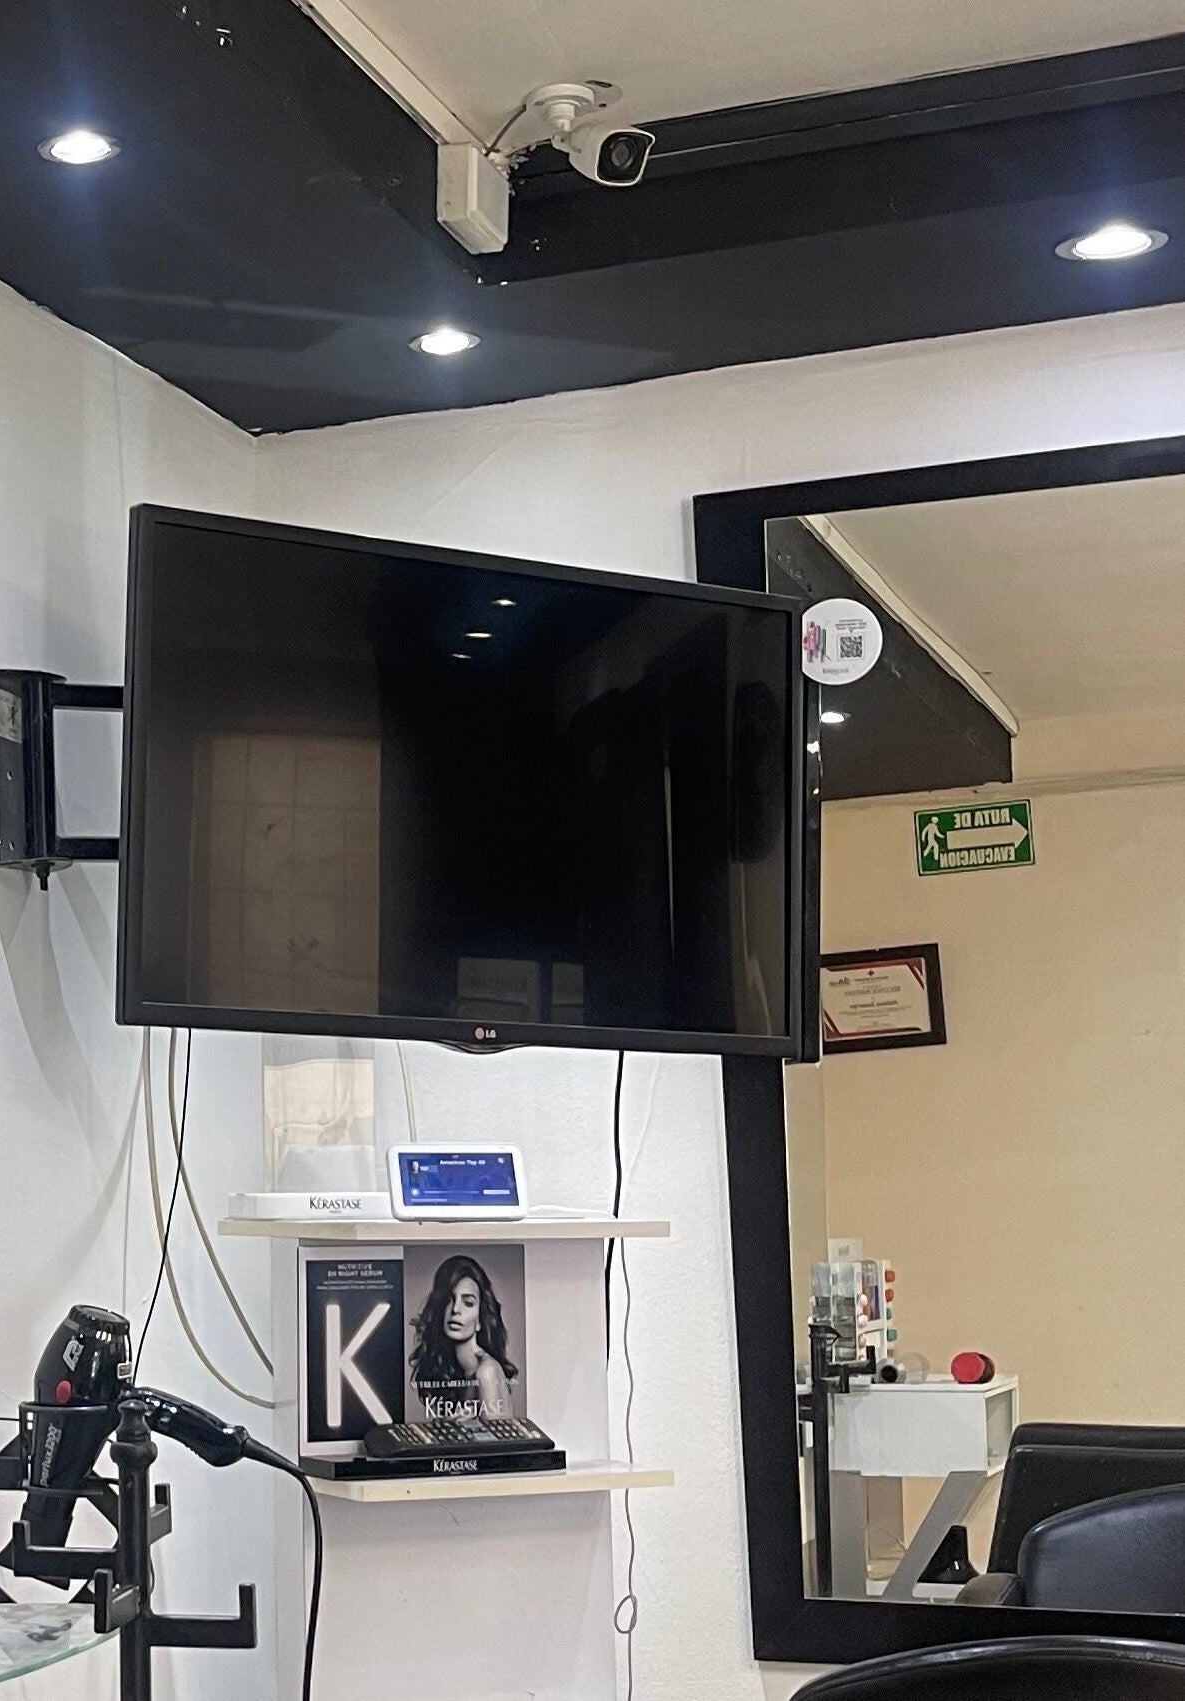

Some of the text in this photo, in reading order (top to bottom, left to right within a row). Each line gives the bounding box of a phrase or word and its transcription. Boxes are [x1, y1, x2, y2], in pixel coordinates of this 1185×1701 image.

[486, 1029, 496, 1039] LG
[309, 1196, 361, 1210] KÉRASTASE
[325, 1302, 394, 1428] K
[425, 1395, 504, 1419] KÉRASTASE
[433, 1459, 478, 1472] KÉRASTASE
